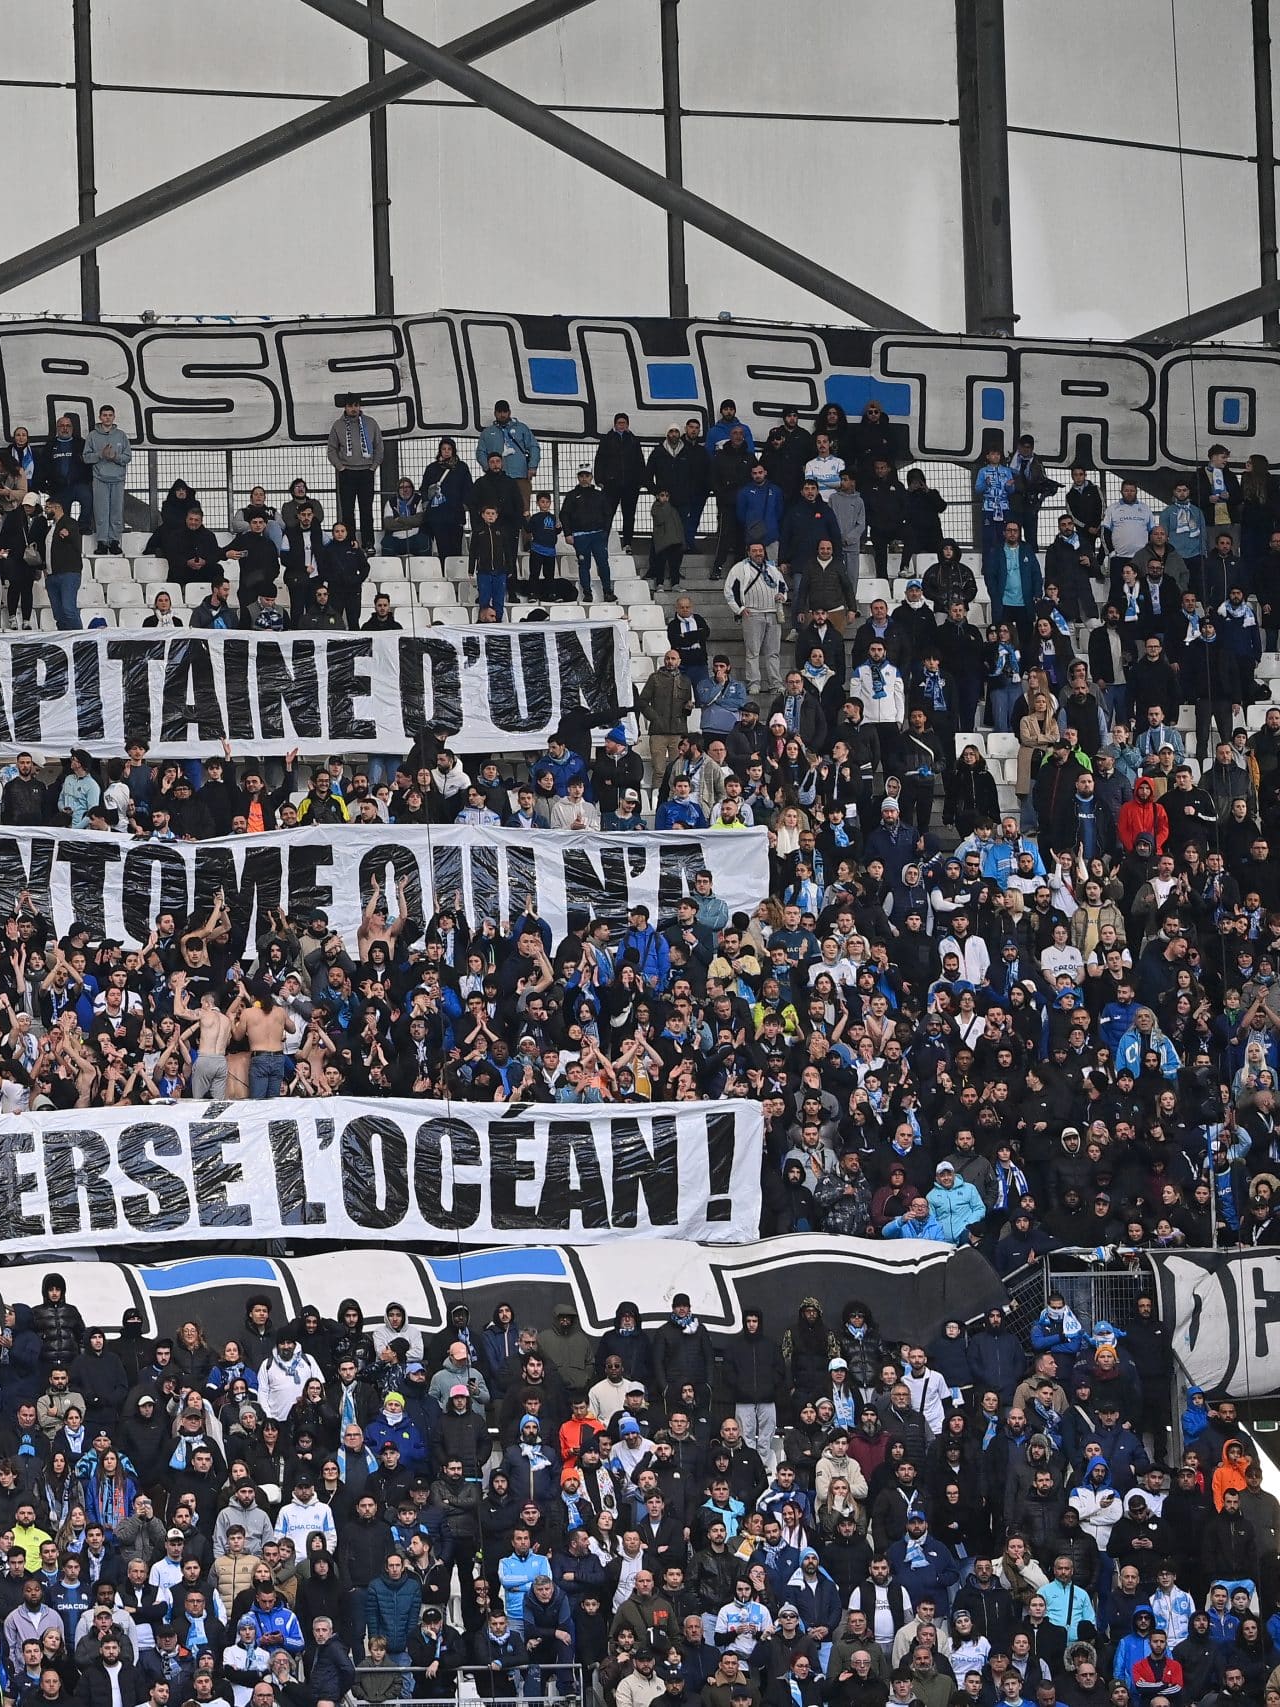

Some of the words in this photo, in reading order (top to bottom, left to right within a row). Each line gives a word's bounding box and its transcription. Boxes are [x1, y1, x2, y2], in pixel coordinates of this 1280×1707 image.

[398, 626, 620, 739] D'UN
[562, 843, 710, 946] N'A
[267, 1103, 679, 1230] L'OCÉAN
[705, 1112, 735, 1222] !
